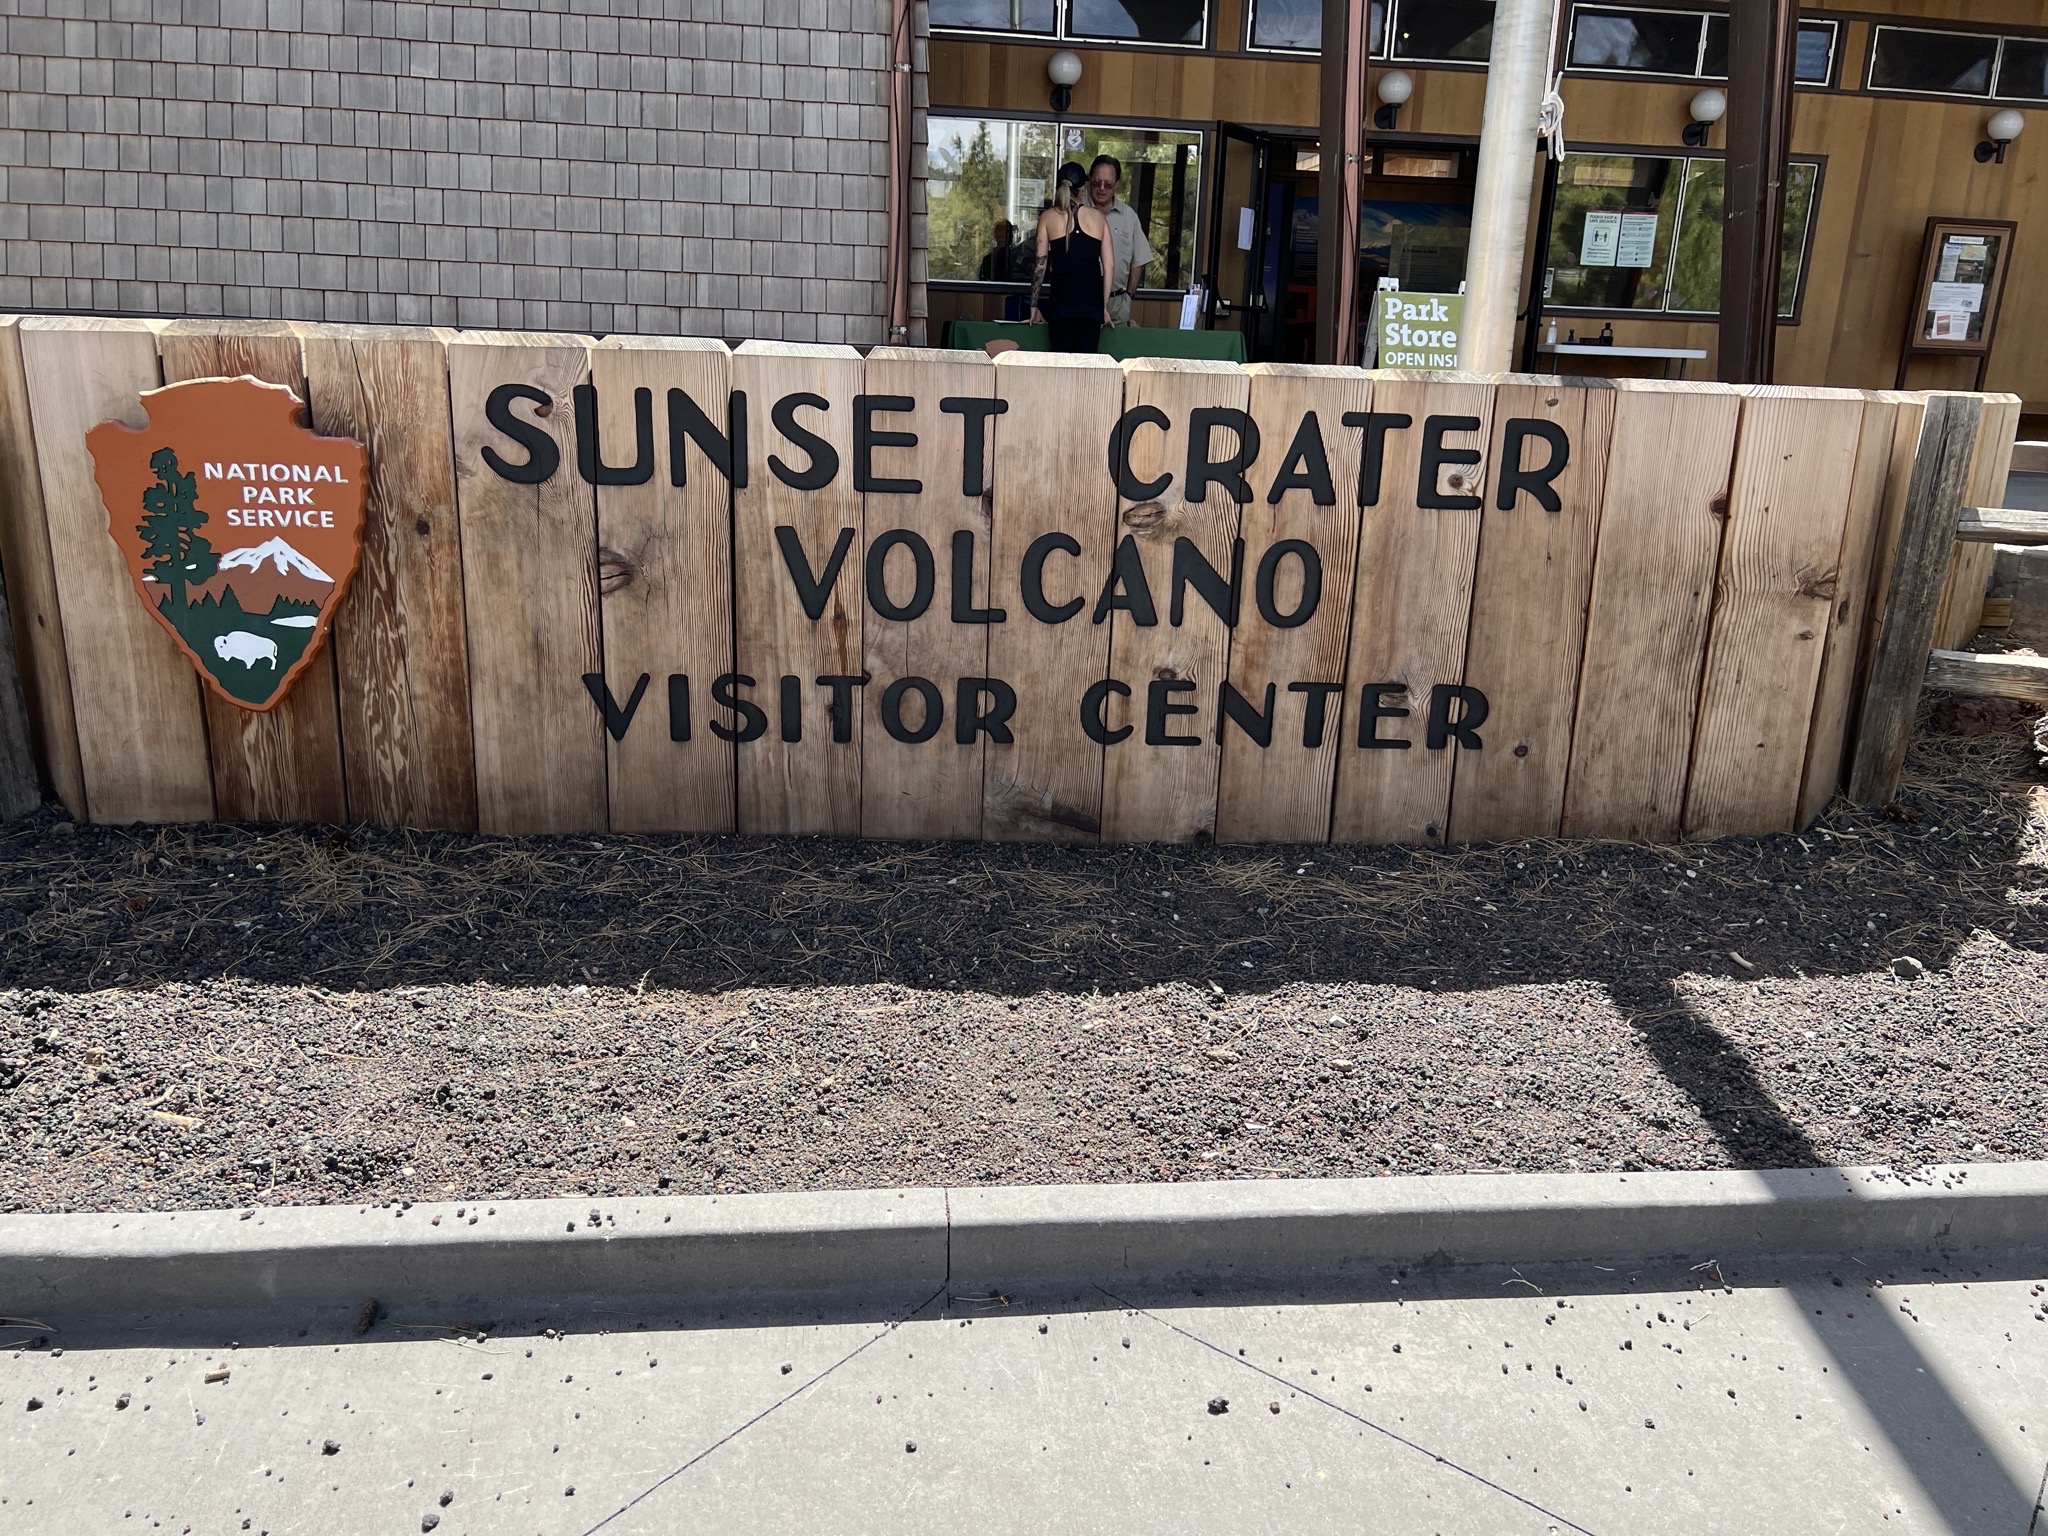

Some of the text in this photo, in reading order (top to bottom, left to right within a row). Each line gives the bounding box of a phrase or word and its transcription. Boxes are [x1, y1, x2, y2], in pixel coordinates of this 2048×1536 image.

[1385, 297, 1449, 321] Park
[1385, 322, 1457, 348] Store
[1385, 351, 1425, 366] OPEN
[481, 383, 1571, 512] SUNSET CRATER
[204, 462, 349, 483] NATIONAL
[243, 486, 316, 505] PARK
[226, 508, 335, 528] SERVICE
[774, 525, 1322, 628] VOLCANO
[582, 672, 1490, 750] VISITOR CENTER
